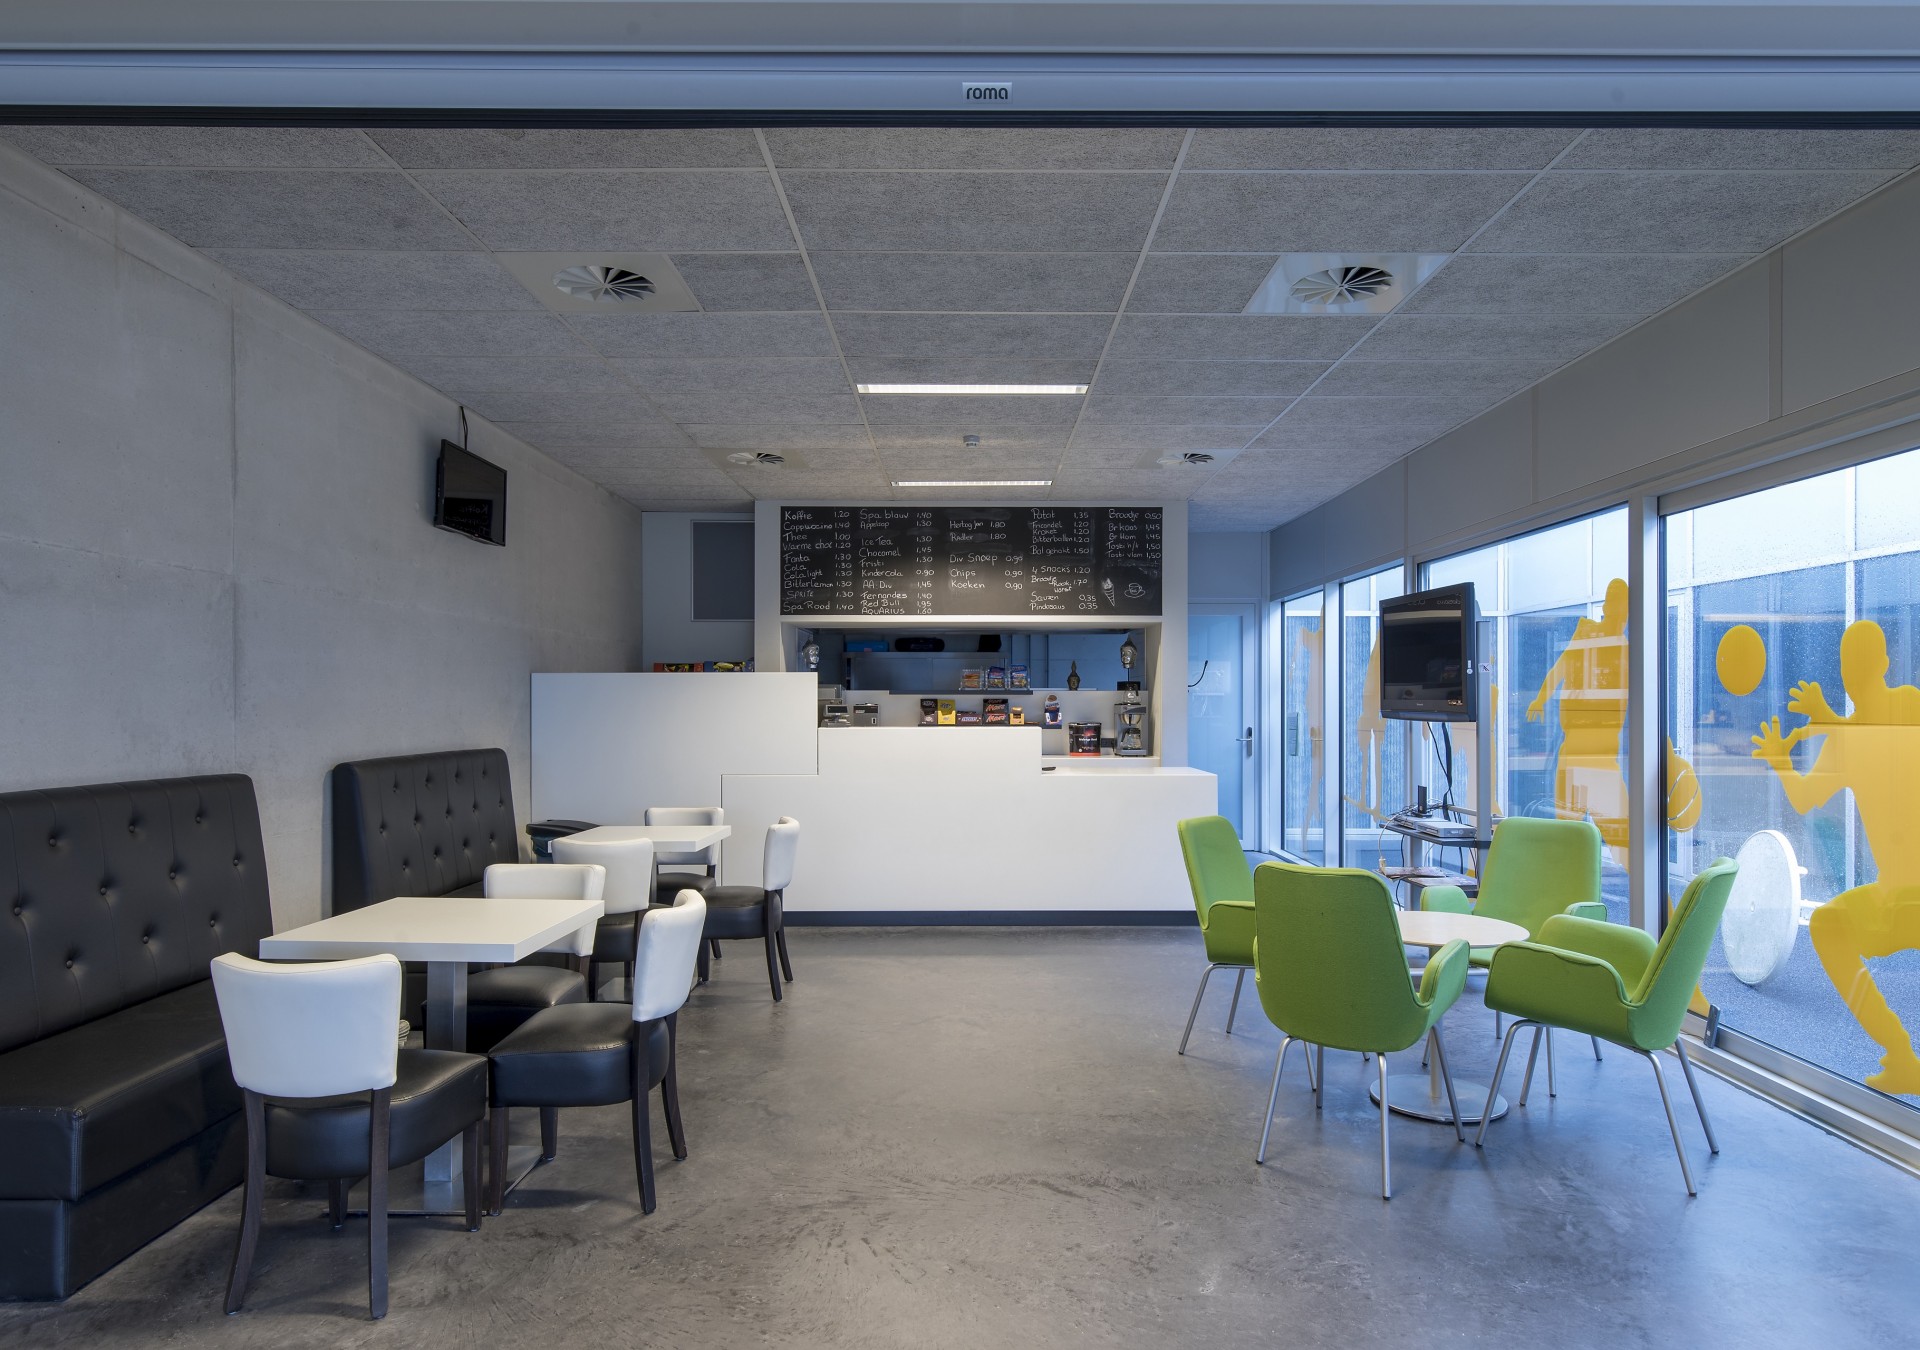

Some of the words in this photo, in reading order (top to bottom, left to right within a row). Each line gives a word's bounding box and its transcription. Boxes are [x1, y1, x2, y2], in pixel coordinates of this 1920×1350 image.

[967, 88, 1008, 100] roma
[785, 510, 812, 520] Koffie
[860, 508, 882, 522] Spa
[885, 510, 908, 518] blauw
[1031, 508, 1055, 519] Patat
[784, 522, 832, 532] Cappuccino
[950, 520, 972, 530] Hertog
[783, 531, 808, 541] Thee
[862, 538, 874, 546] Ice
[875, 536, 893, 545] Tea
[950, 532, 973, 541] Radler
[859, 547, 901, 557] Chocomel
[1030, 545, 1043, 555] Bal
[783, 552, 810, 563] Fanta
[859, 558, 884, 567] Fristi
[950, 554, 963, 563] Div
[968, 553, 997, 566] Snoep
[950, 568, 976, 579] Chips
[951, 580, 985, 588] Koeken
[861, 591, 907, 600] Fernandes
[1031, 591, 1059, 602] Sauzen
[783, 602, 804, 613] Spa
[804, 601, 830, 609] Rood
[986, 714, 1006, 722] Mars
